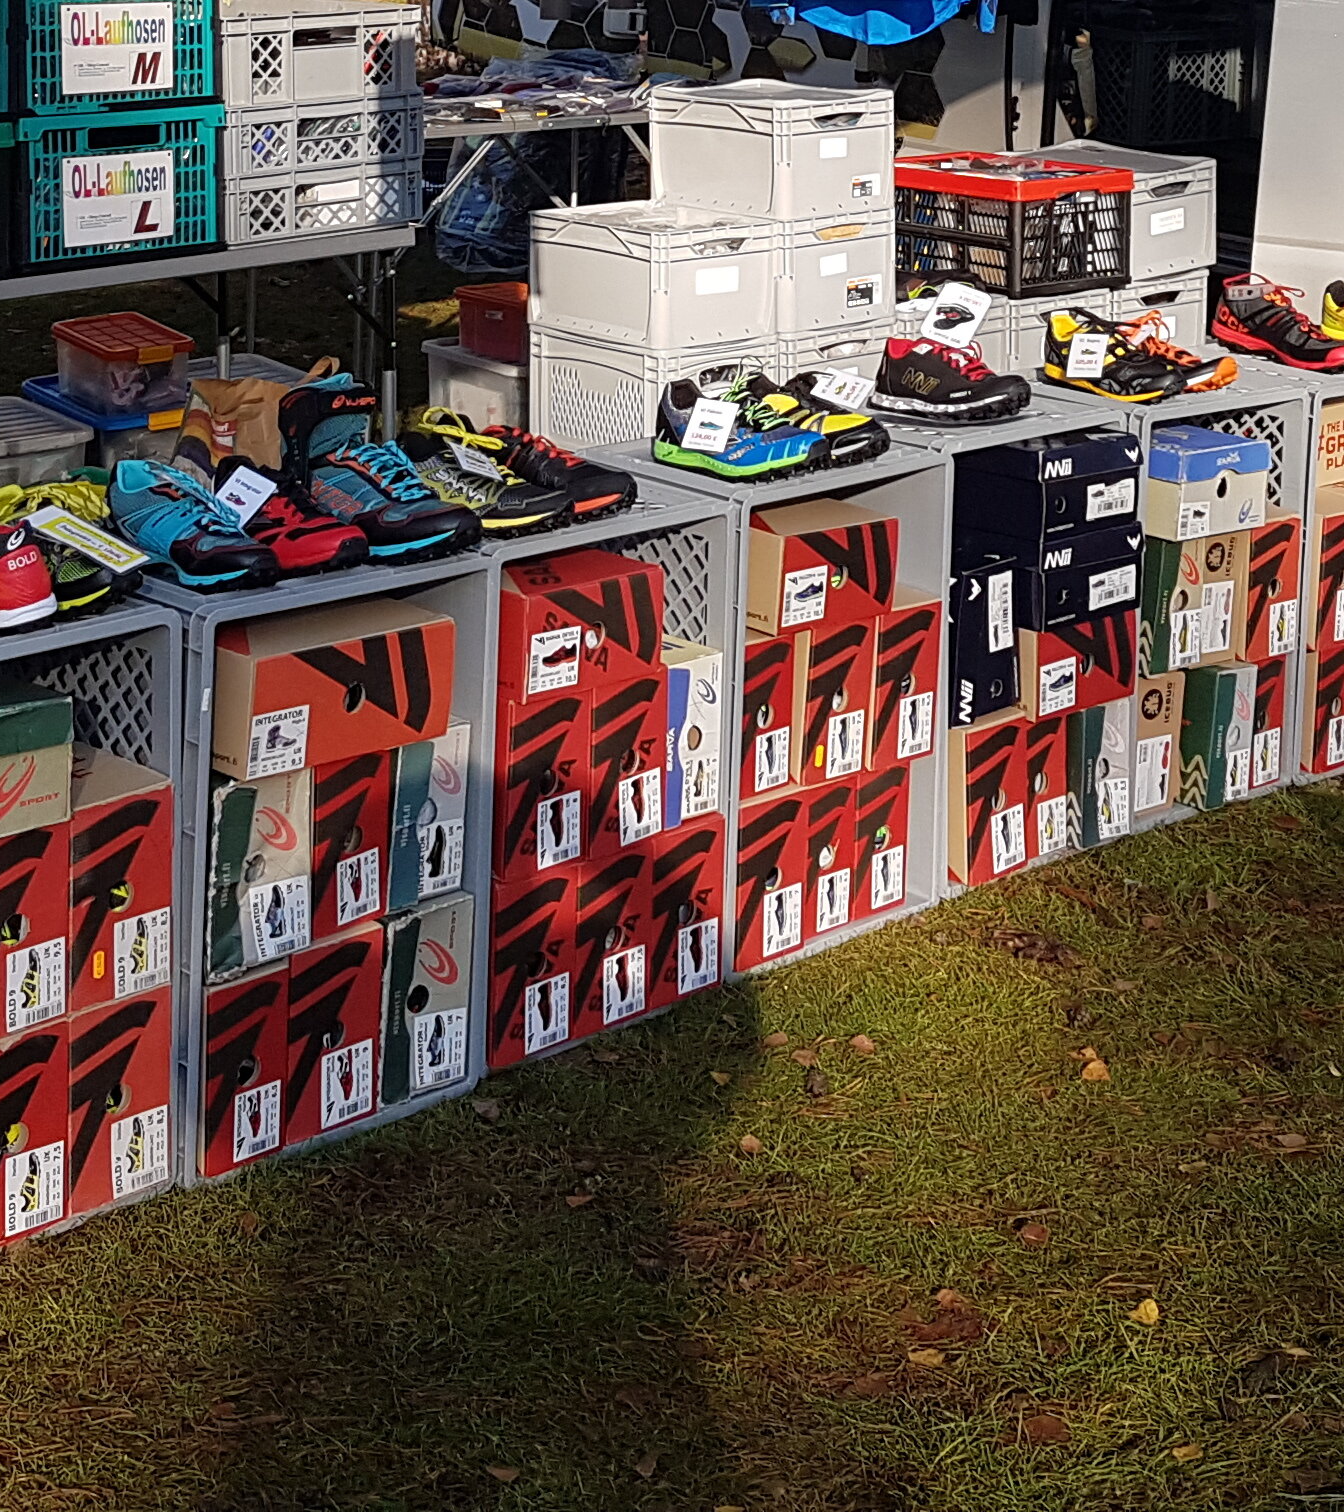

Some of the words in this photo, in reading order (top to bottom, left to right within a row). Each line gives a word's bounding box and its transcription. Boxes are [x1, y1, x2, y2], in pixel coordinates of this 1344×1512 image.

[71, 10, 166, 47] OL-Laufhosen
[131, 51, 162, 86] M
[71, 160, 167, 200] OL-Laufhosen
[133, 200, 160, 235] L
[1326, 420, 1341, 435] THE
[7, 551, 39, 571] BOLD
[1225, 536, 1236, 577] ICEBUG
[254, 709, 304, 727] INTEGRATOR
[1164, 683, 1174, 724] ICEBUG
[19, 791, 61, 808] SPORT
[253, 901, 268, 958] INTEGRATOR
[8, 998, 16, 1028] BOLD
[417, 1030, 426, 1085] INTEGRATOR
[115, 1165, 123, 1193] BOLD
[8, 1203, 16, 1231] BOLD
